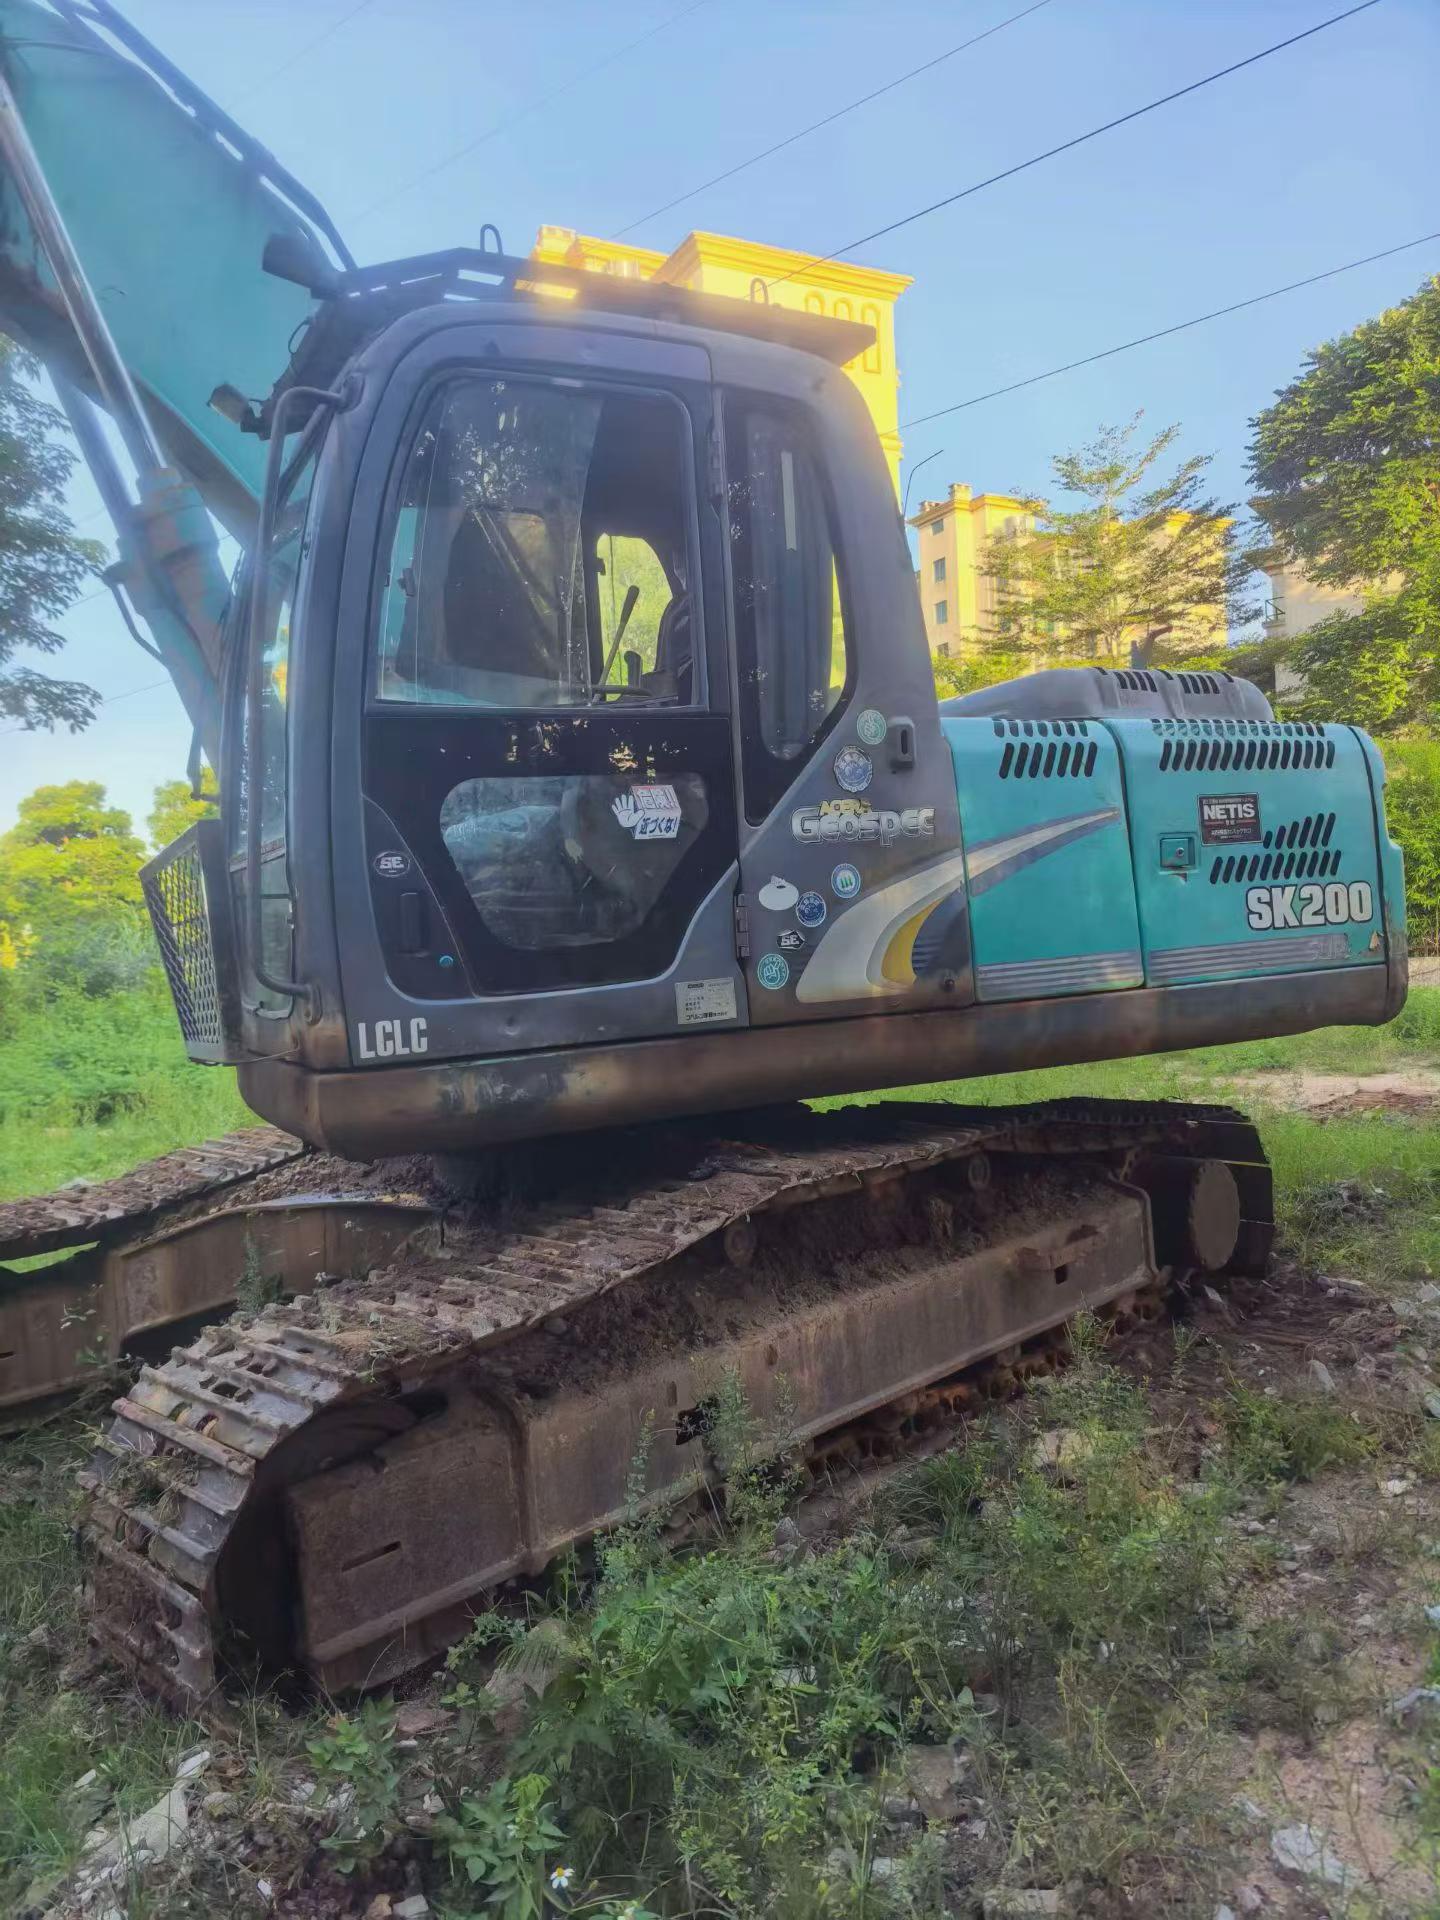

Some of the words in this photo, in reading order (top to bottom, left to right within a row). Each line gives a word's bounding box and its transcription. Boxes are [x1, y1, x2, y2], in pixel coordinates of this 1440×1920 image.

[1203, 804, 1256, 820] NETIS
[1247, 881, 1374, 931] SK200
[358, 1018, 428, 1059] LCLC
